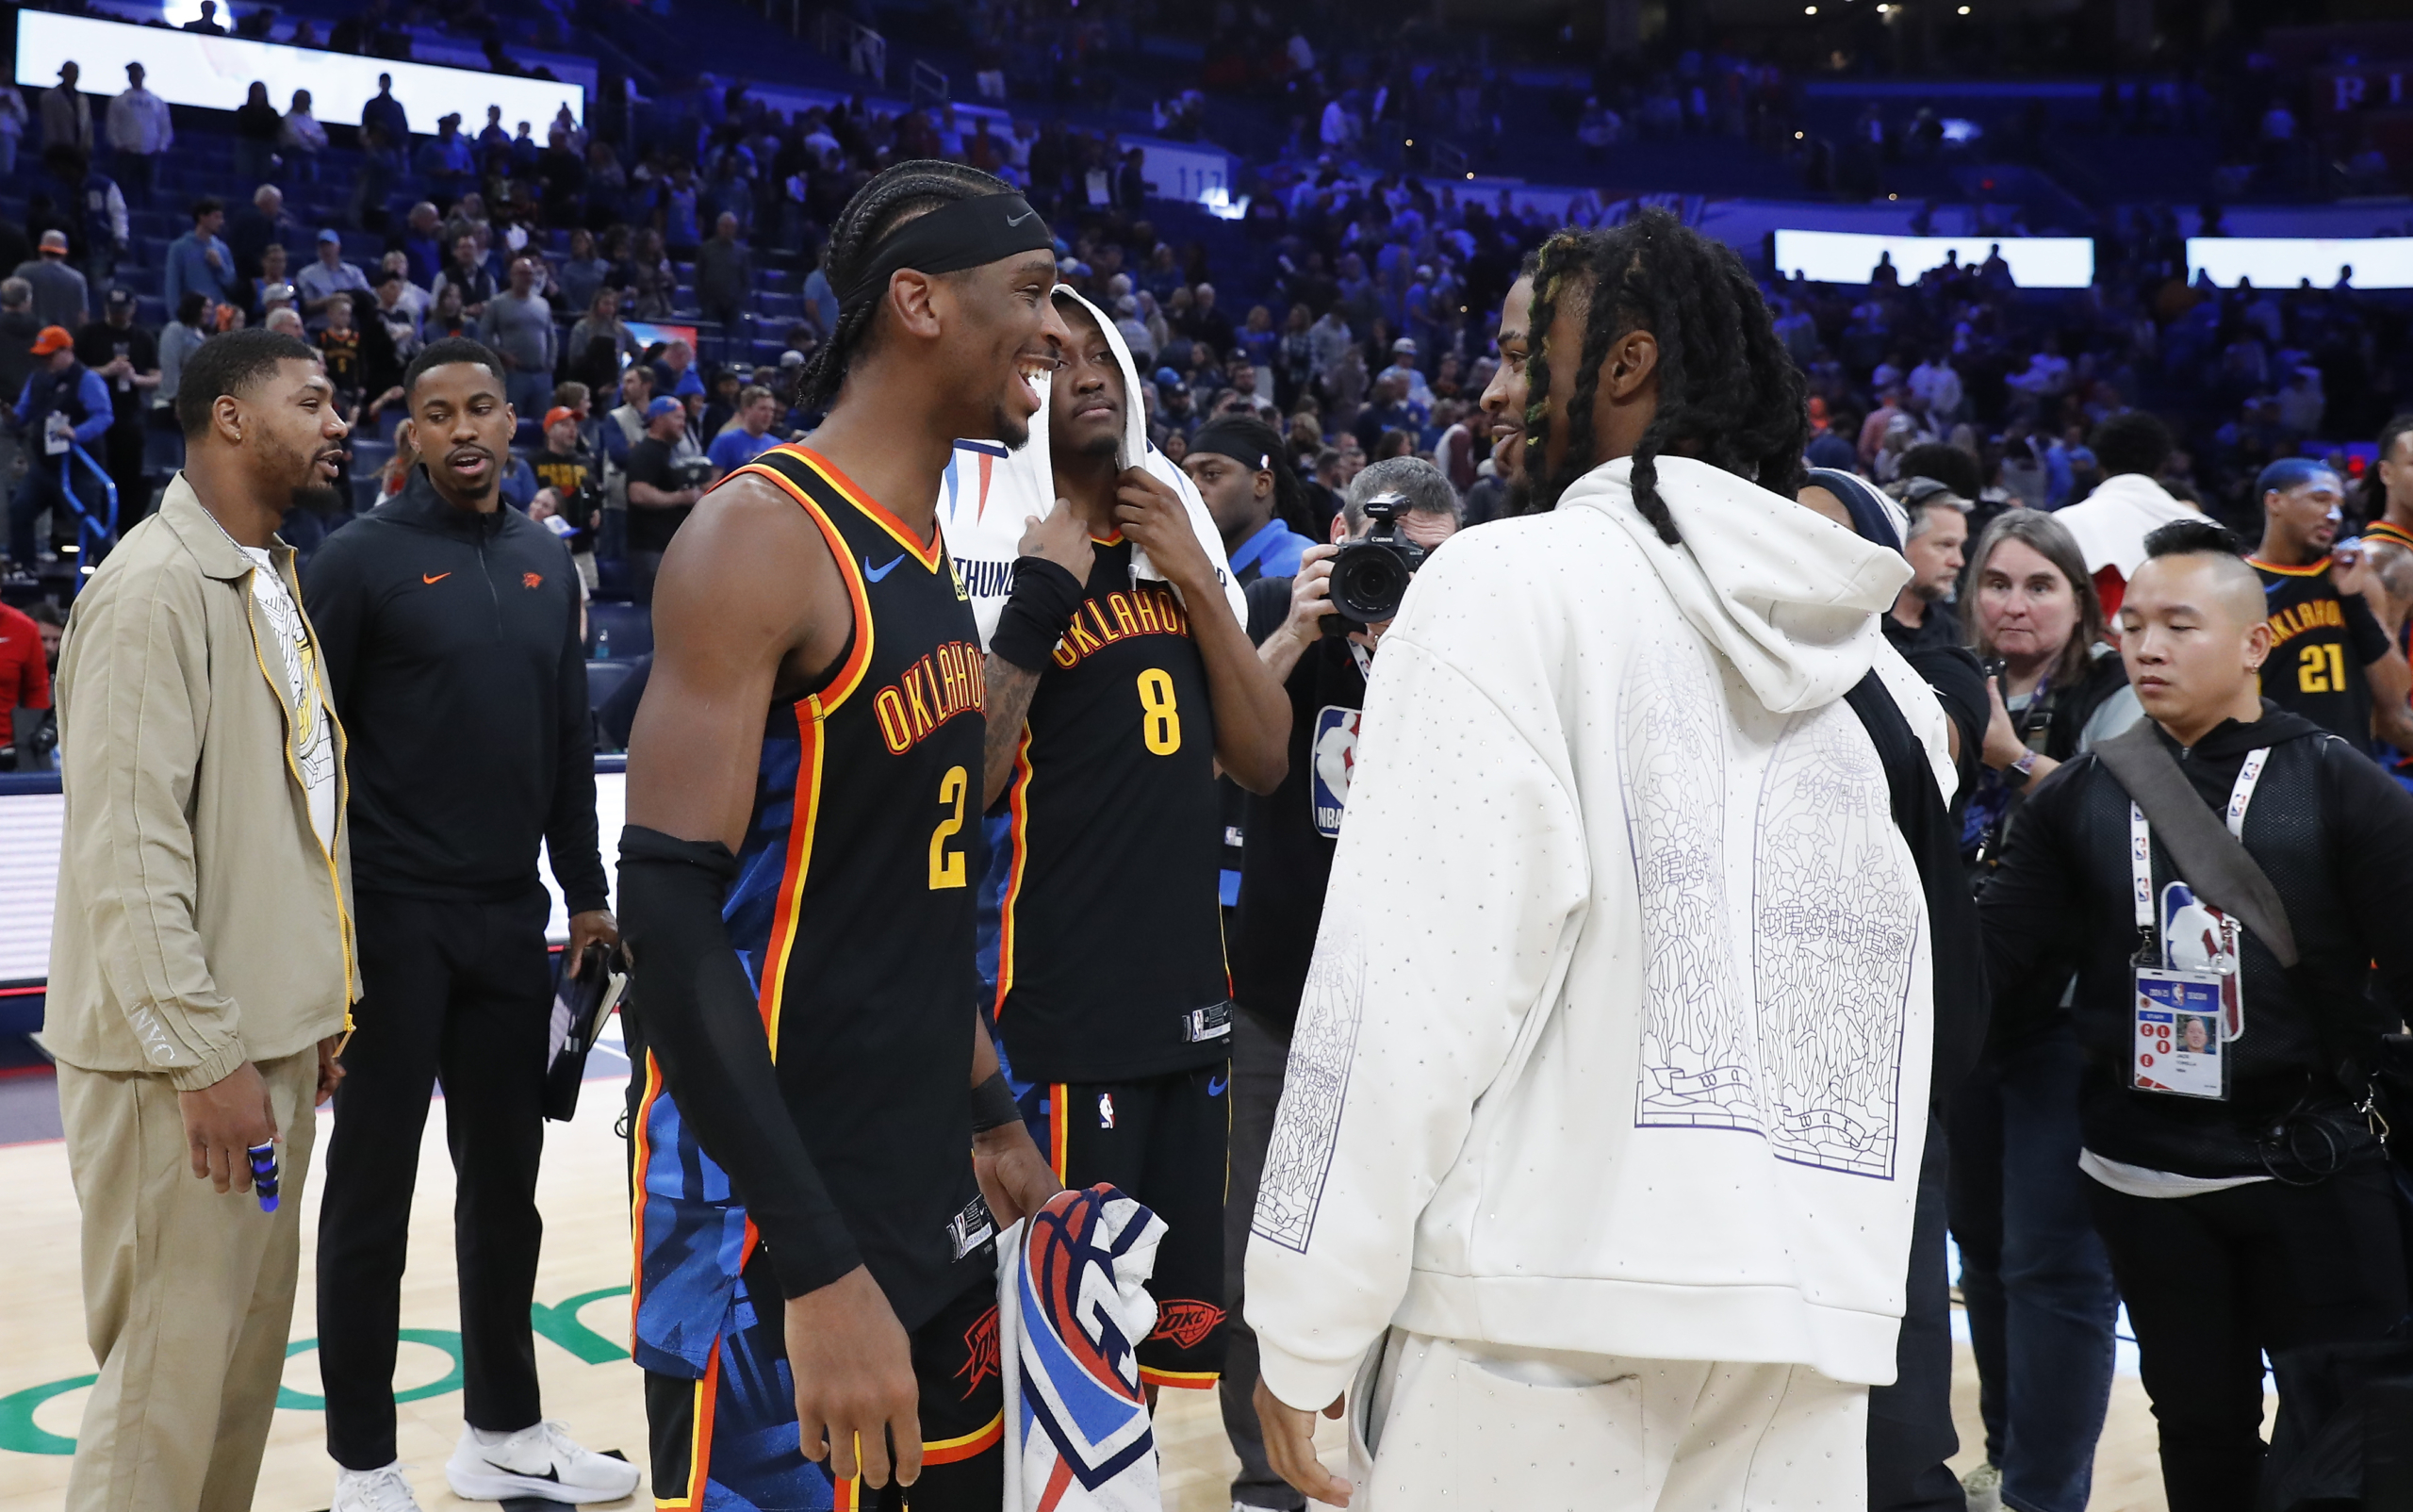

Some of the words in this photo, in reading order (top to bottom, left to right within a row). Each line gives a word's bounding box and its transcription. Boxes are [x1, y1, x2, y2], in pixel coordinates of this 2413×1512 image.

[2267, 598, 2348, 649] KLAHO
[2298, 643, 2346, 694] 21
[1137, 667, 1182, 757] 8
[928, 764, 968, 891] 2
[1318, 806, 1344, 830] NBA
[1798, 1112, 1852, 1132] war
[1157, 1309, 1206, 1333] OKC
